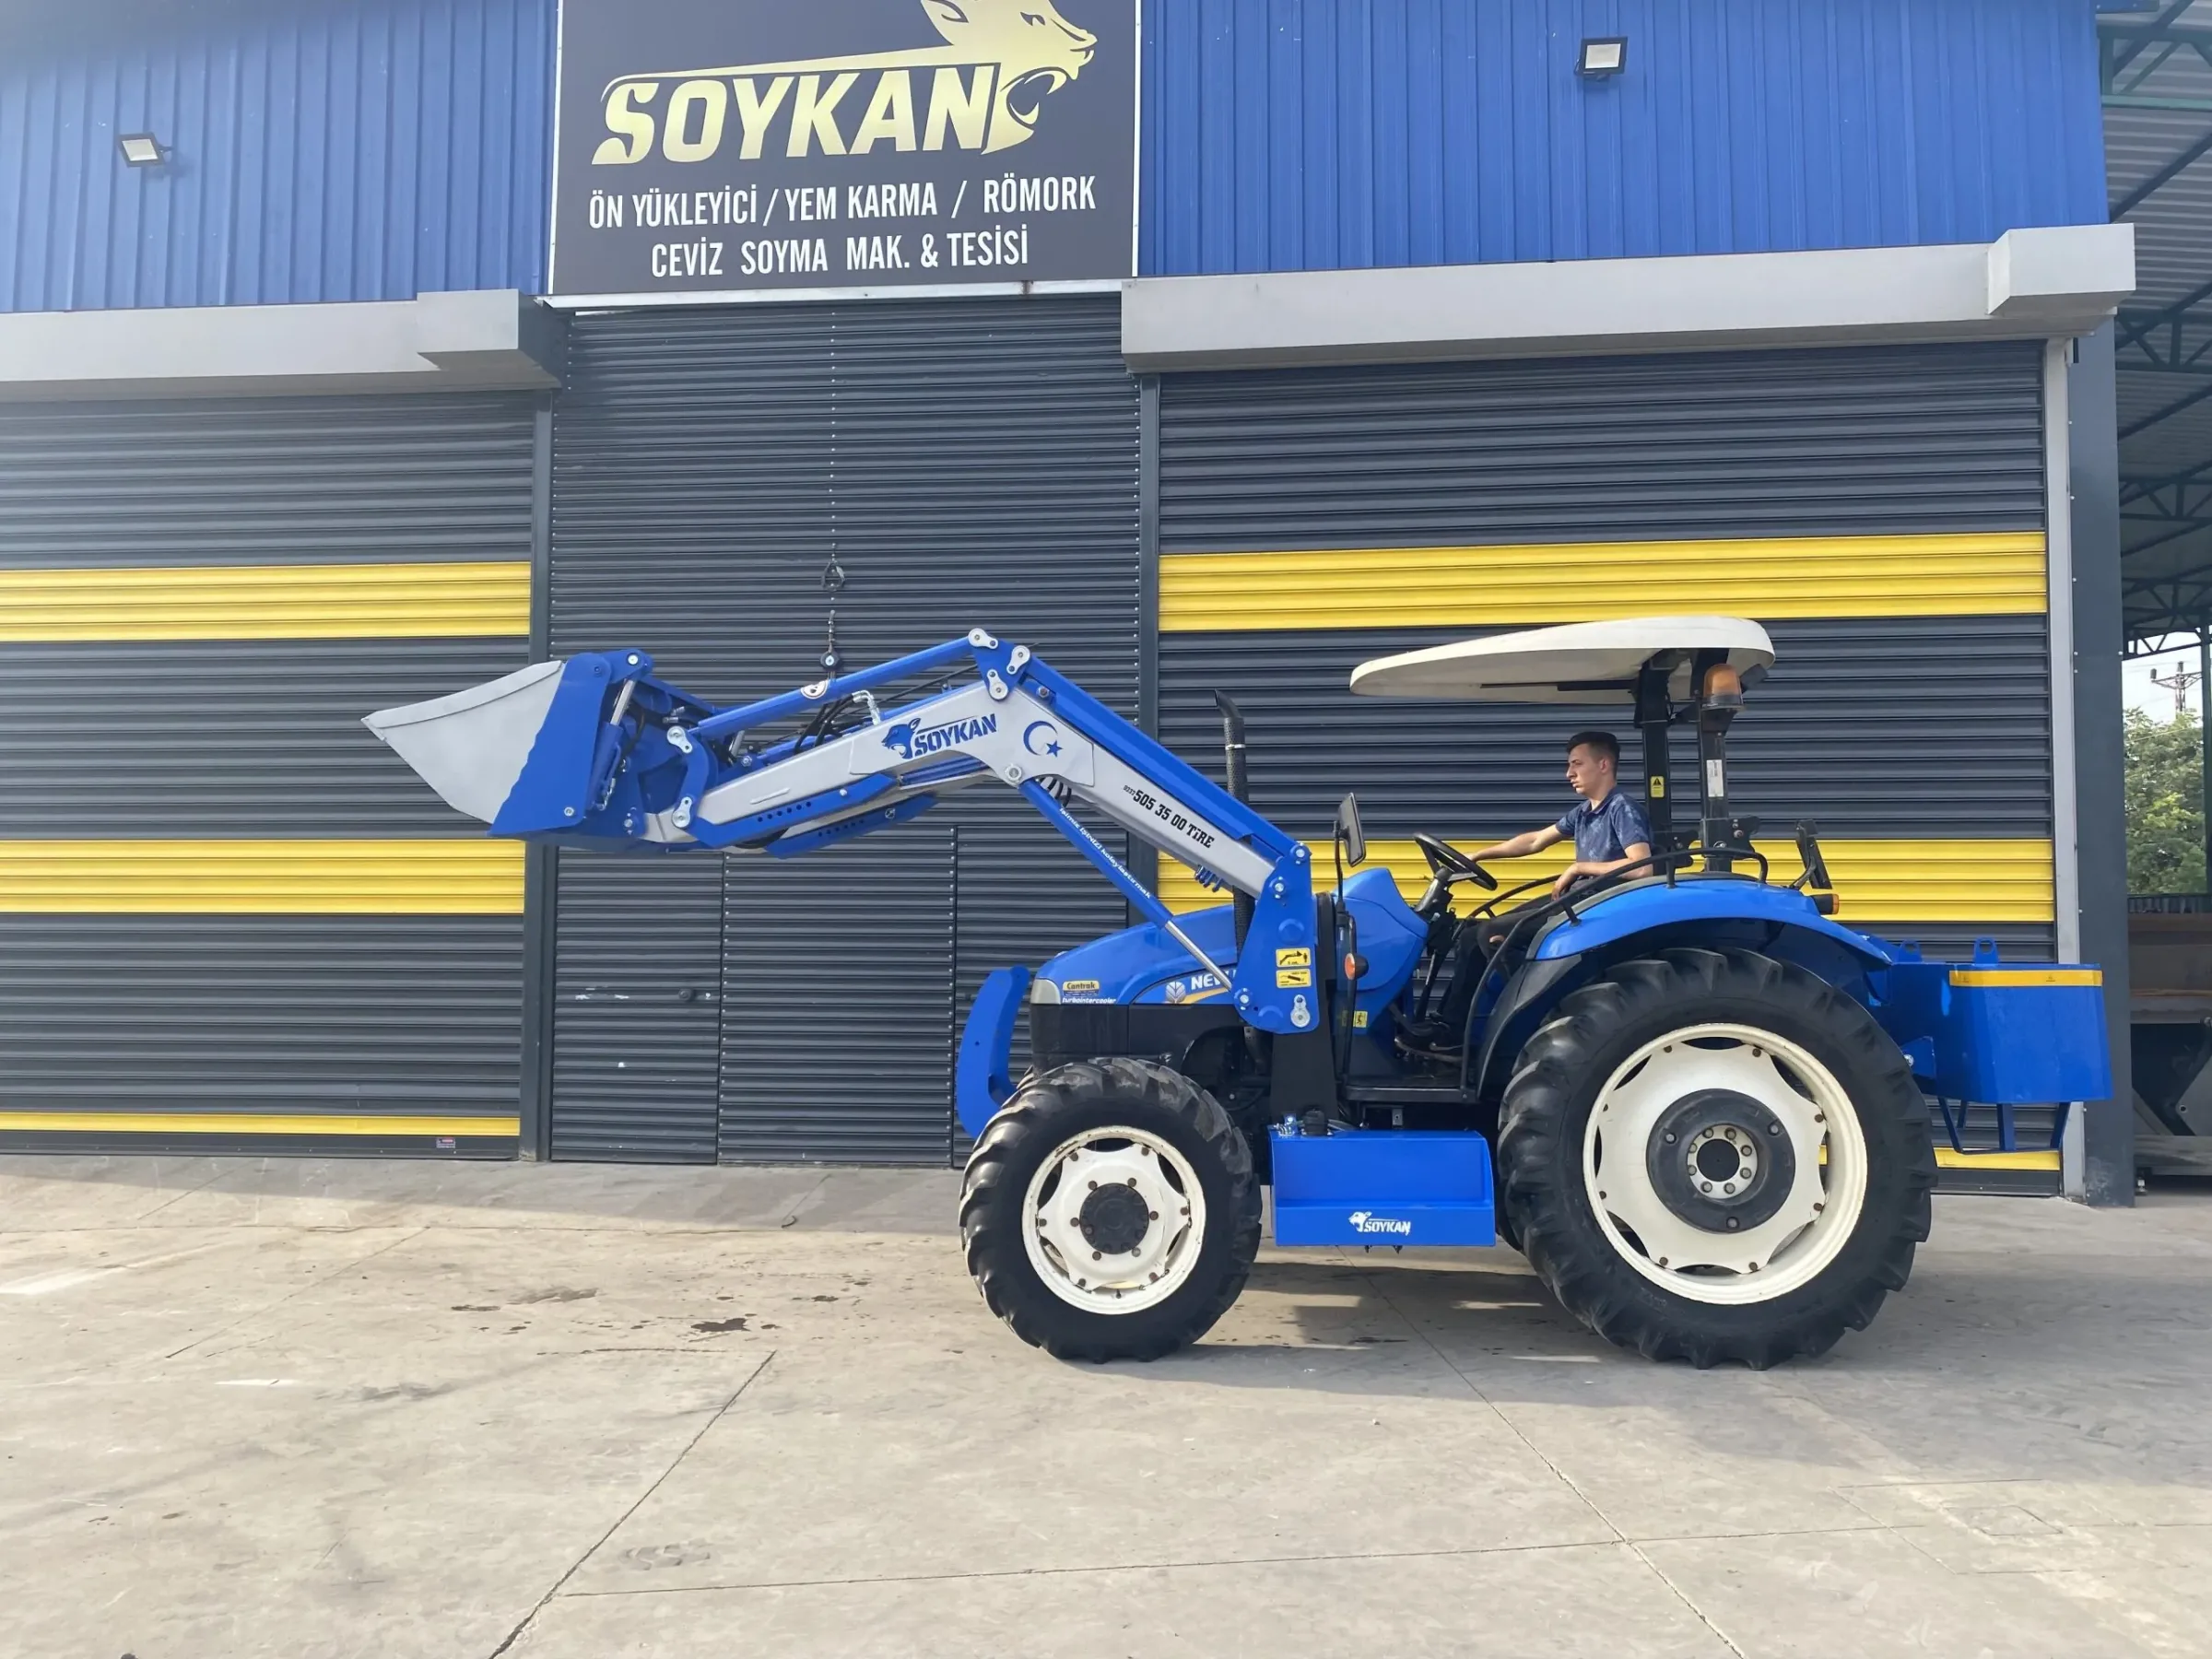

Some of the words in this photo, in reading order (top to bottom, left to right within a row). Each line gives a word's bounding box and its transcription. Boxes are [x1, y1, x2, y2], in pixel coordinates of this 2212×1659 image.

[592, 65, 995, 166] SOYKAN
[589, 189, 623, 229] ÖN
[632, 184, 757, 228] YÜKLEYİCİ
[785, 186, 837, 222] YEM
[848, 182, 938, 219] KARMA
[983, 172, 1097, 214] RÖMORK
[652, 237, 724, 277] CEVİZ
[741, 238, 829, 275] SOYMA
[846, 235, 911, 271] MAK.
[921, 232, 939, 268] &
[947, 224, 1029, 267] TESİSİ
[914, 712, 997, 757] SOYKAN
[1154, 804, 1172, 821] 35
[1170, 814, 1188, 831] 00
[1363, 1220, 1412, 1236] SOYKAN
